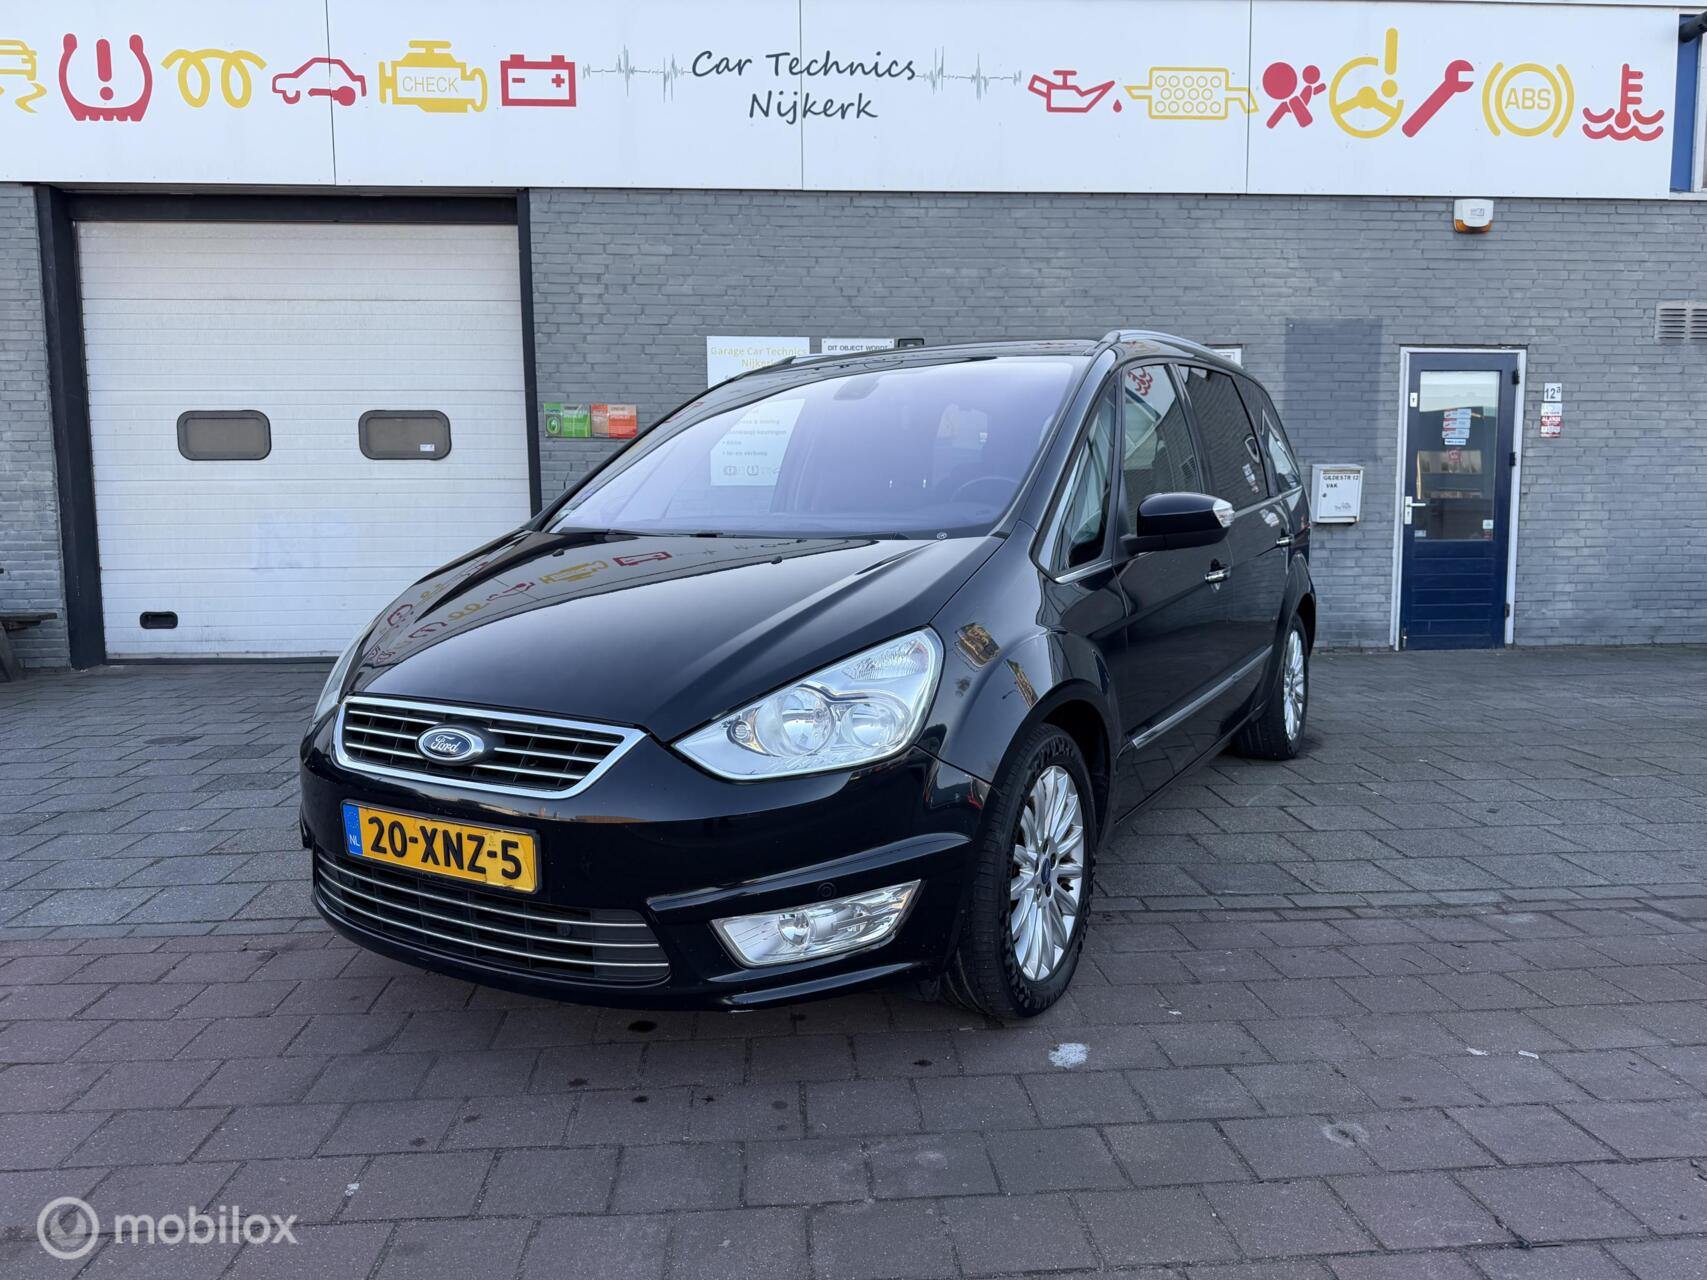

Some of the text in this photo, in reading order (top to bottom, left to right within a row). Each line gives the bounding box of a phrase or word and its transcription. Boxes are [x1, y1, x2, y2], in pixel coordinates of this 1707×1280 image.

[691, 50, 916, 81] Car Technics
[402, 76, 459, 93] CHECK
[749, 90, 879, 125] Nijkerk
[1504, 87, 1552, 111] ABS
[710, 346, 744, 357] Garage
[747, 346, 762, 355] Car
[430, 734, 461, 754] Ford
[349, 834, 360, 848] NL
[367, 816, 522, 880] 20-XNZ-5
